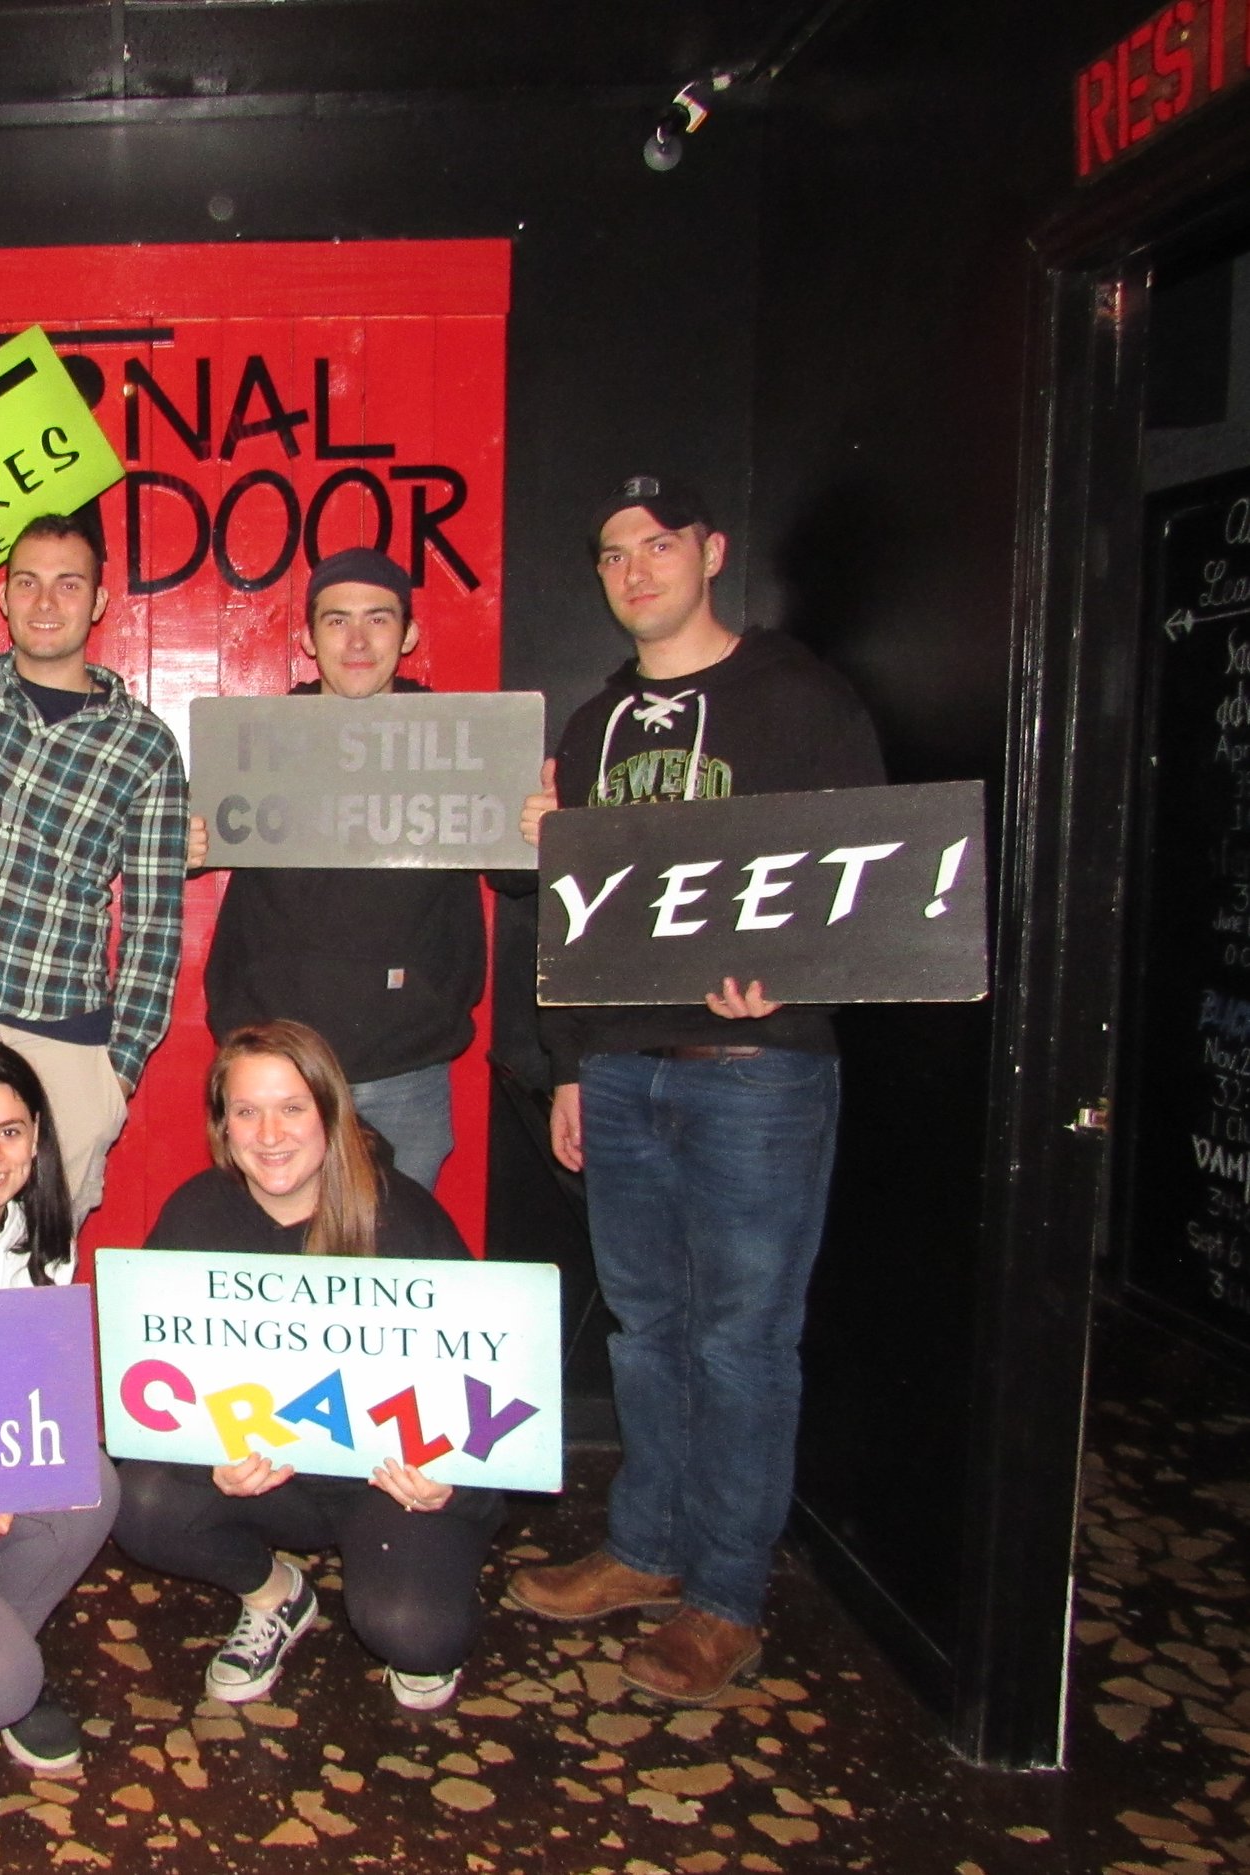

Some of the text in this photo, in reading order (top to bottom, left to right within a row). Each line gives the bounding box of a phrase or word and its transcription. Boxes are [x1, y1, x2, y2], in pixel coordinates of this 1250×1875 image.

[1076, 0, 1250, 177] REST
[124, 465, 481, 596] DOOR
[337, 719, 485, 773] STILL
[550, 836, 968, 946] YEET!
[142, 1313, 508, 1362] BRINGS OUT MY
[206, 1269, 435, 1309] ESCAPING
[120, 1358, 541, 1469] CRAZY
